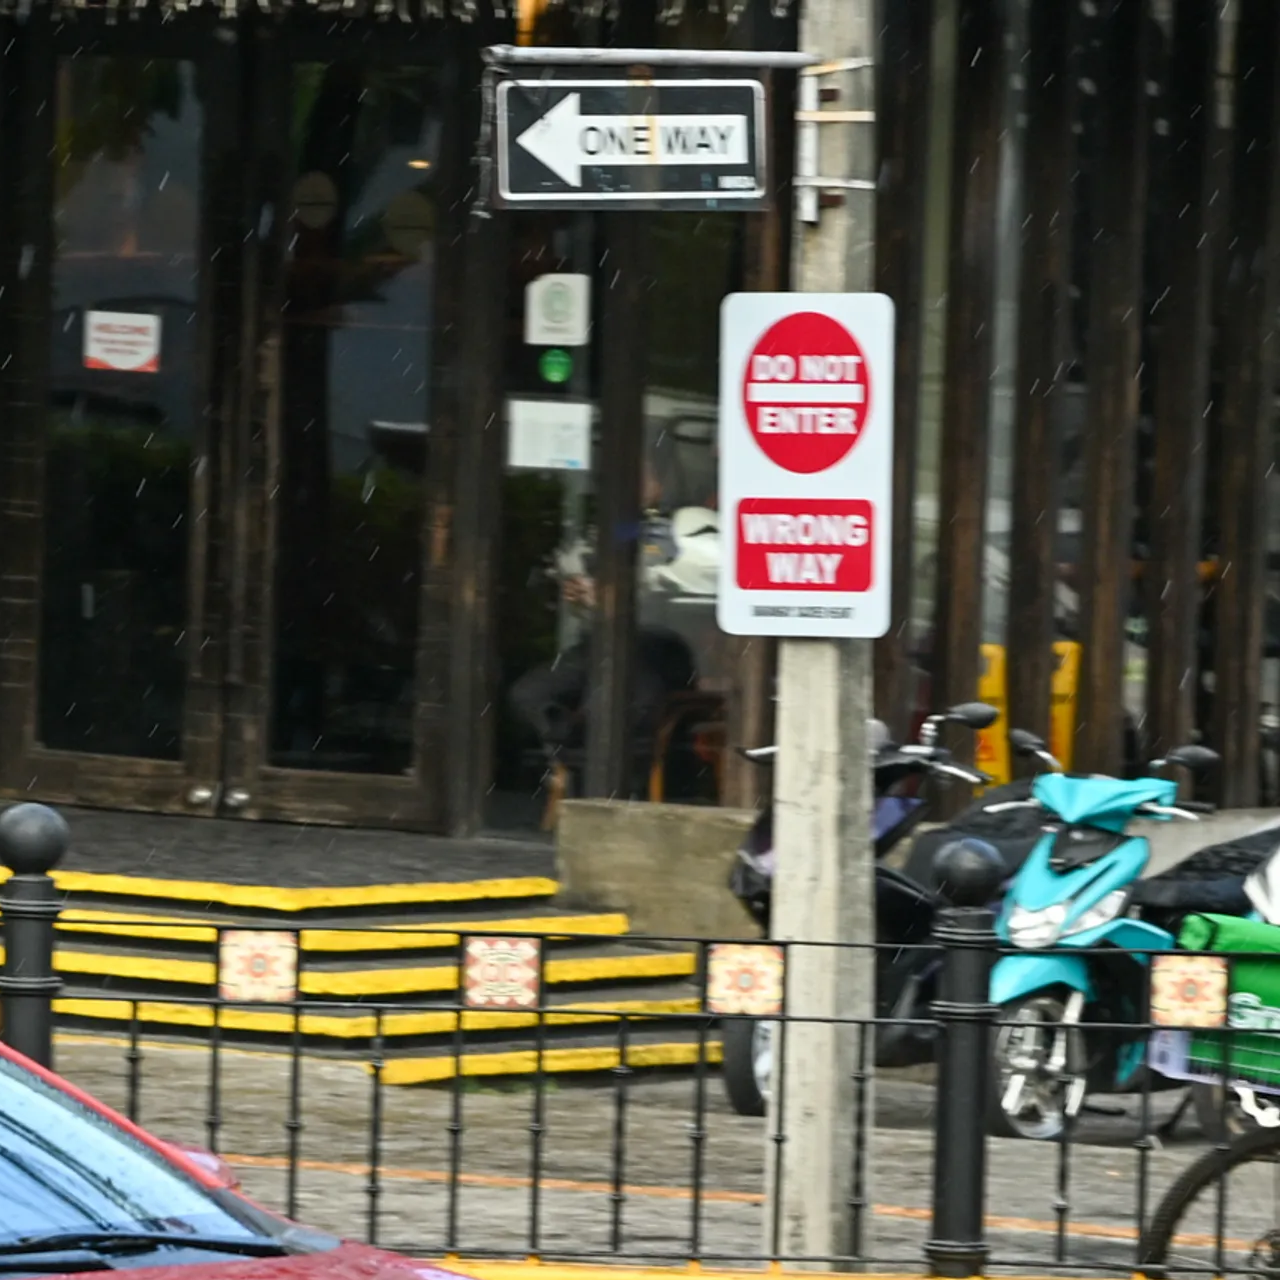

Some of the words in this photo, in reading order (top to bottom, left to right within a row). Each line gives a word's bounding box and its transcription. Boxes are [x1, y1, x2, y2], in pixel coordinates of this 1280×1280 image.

[579, 125, 652, 156] ONE
[660, 125, 736, 156] WAY
[752, 355, 796, 381] DO
[799, 355, 862, 382] NOT
[757, 407, 857, 434] ENTER
[740, 513, 869, 547] WRONG
[765, 553, 843, 584] WAY
